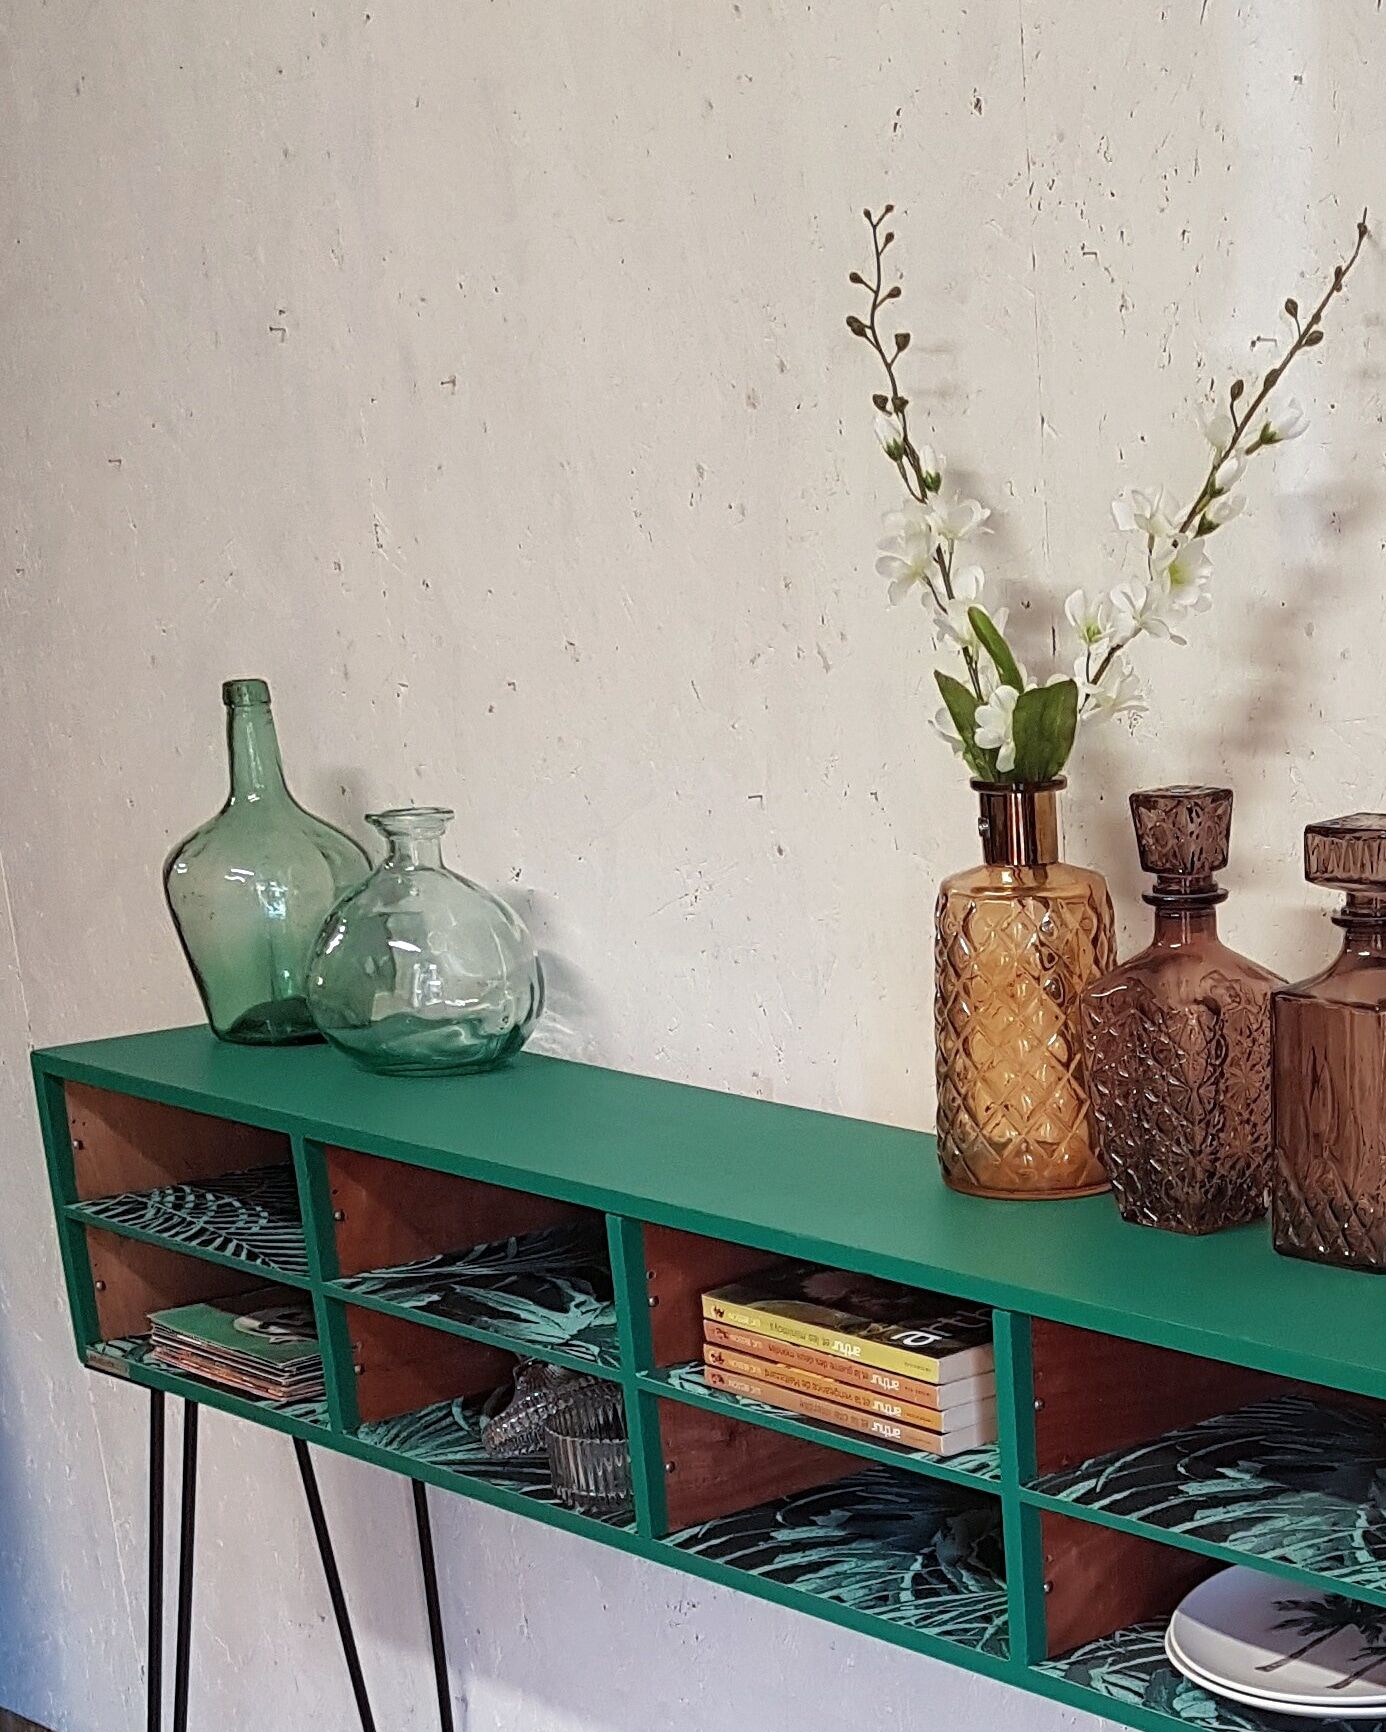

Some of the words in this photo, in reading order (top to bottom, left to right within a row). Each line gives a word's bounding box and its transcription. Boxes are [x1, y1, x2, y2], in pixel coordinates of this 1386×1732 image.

[831, 1339, 860, 1357] arthur
[870, 1373, 899, 1391] arthur
[871, 1399, 900, 1416] arthur
[872, 1421, 900, 1438] arthur
